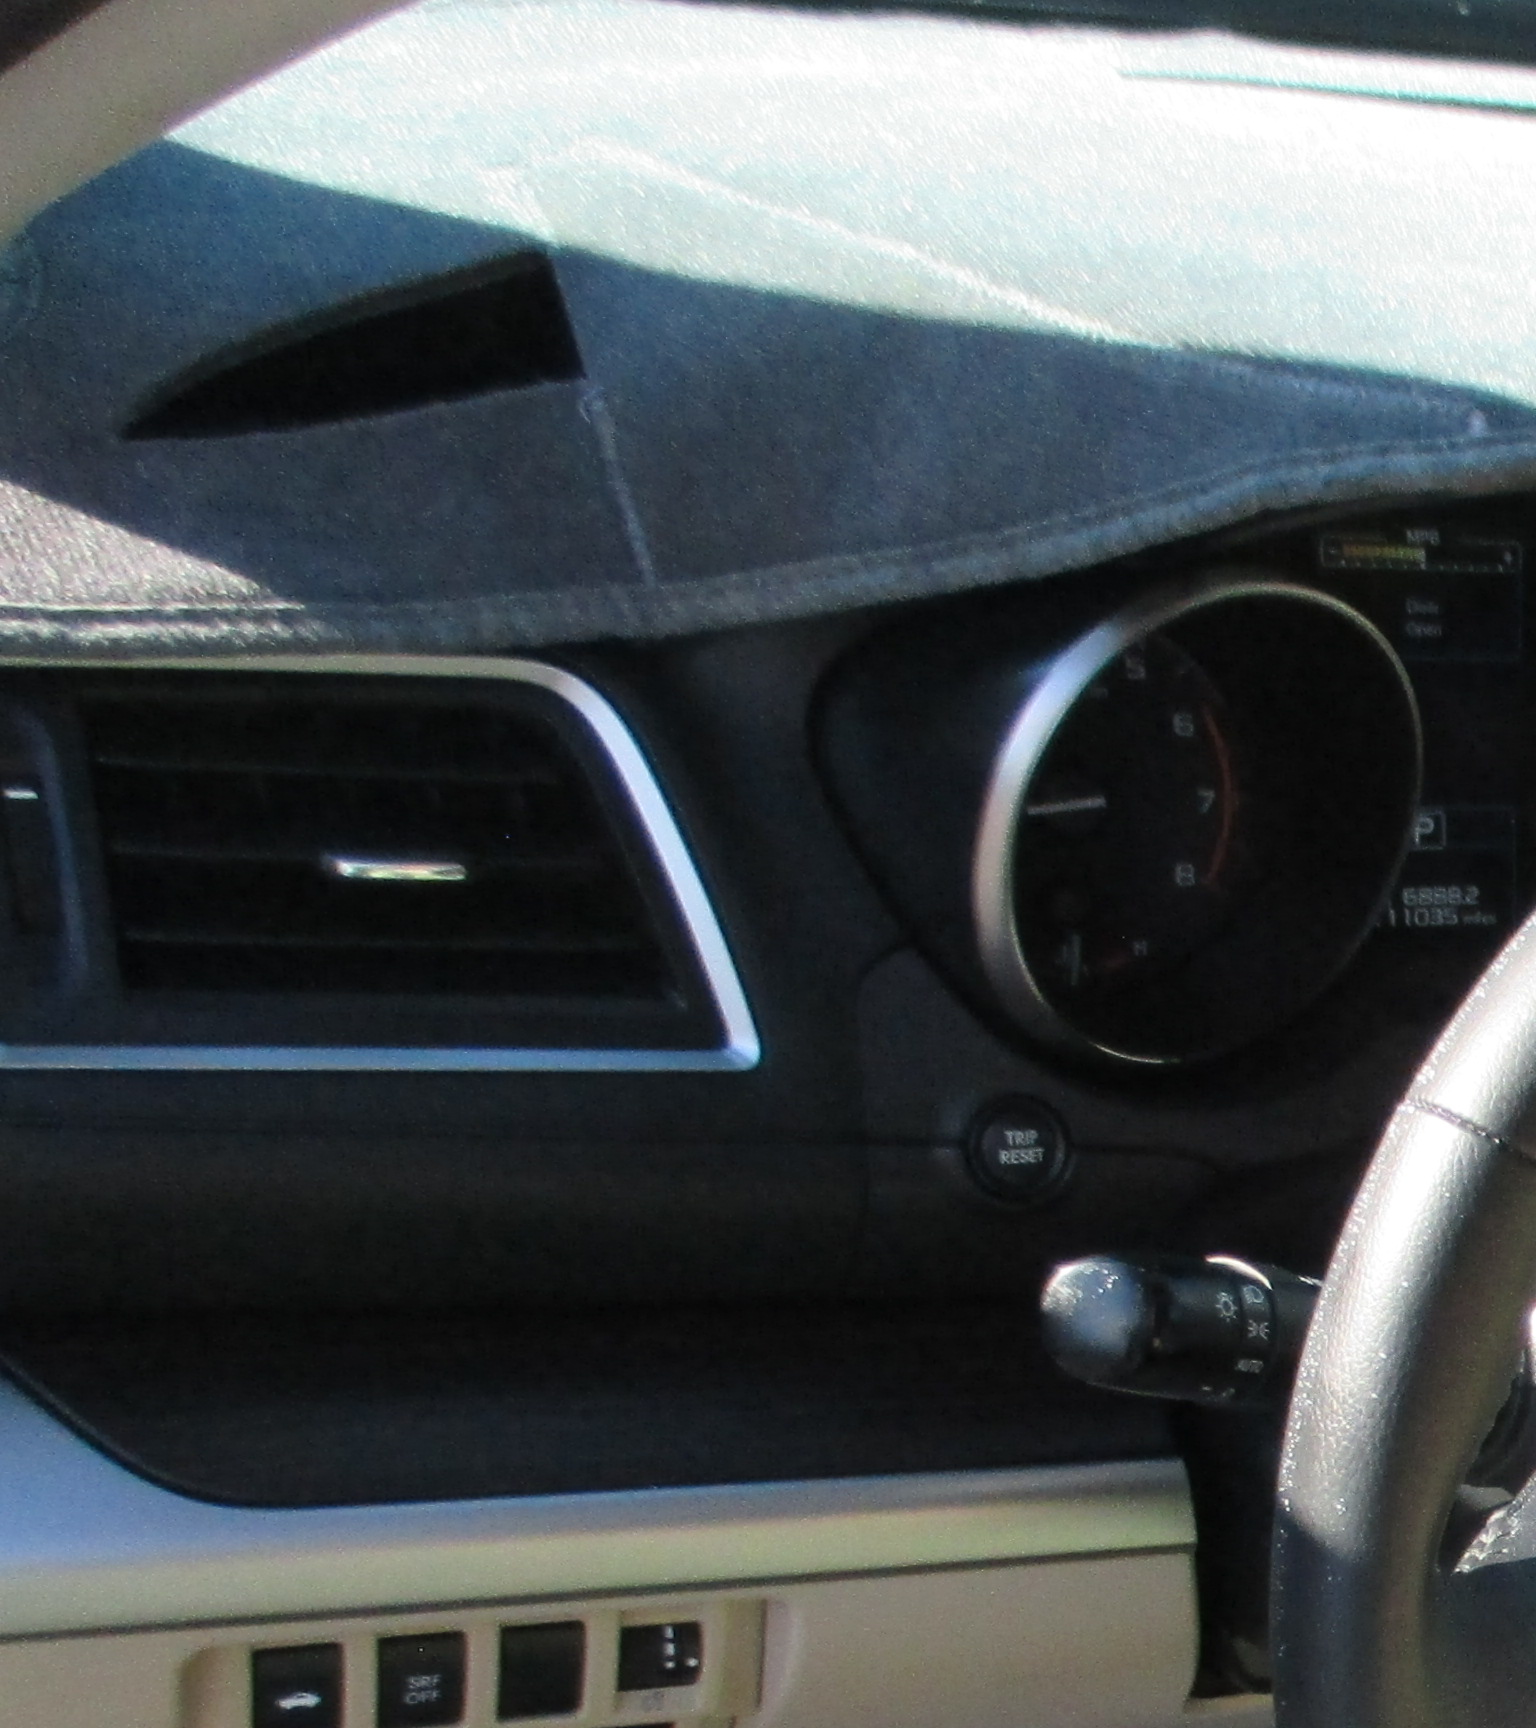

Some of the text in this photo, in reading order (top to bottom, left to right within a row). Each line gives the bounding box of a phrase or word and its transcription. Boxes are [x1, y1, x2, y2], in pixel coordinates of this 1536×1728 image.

[1172, 712, 1196, 738] 6
[1196, 787, 1216, 815] 7
[1414, 816, 1435, 846] P
[1003, 1128, 1039, 1147] TRIP
[999, 1146, 1045, 1165] RESET
